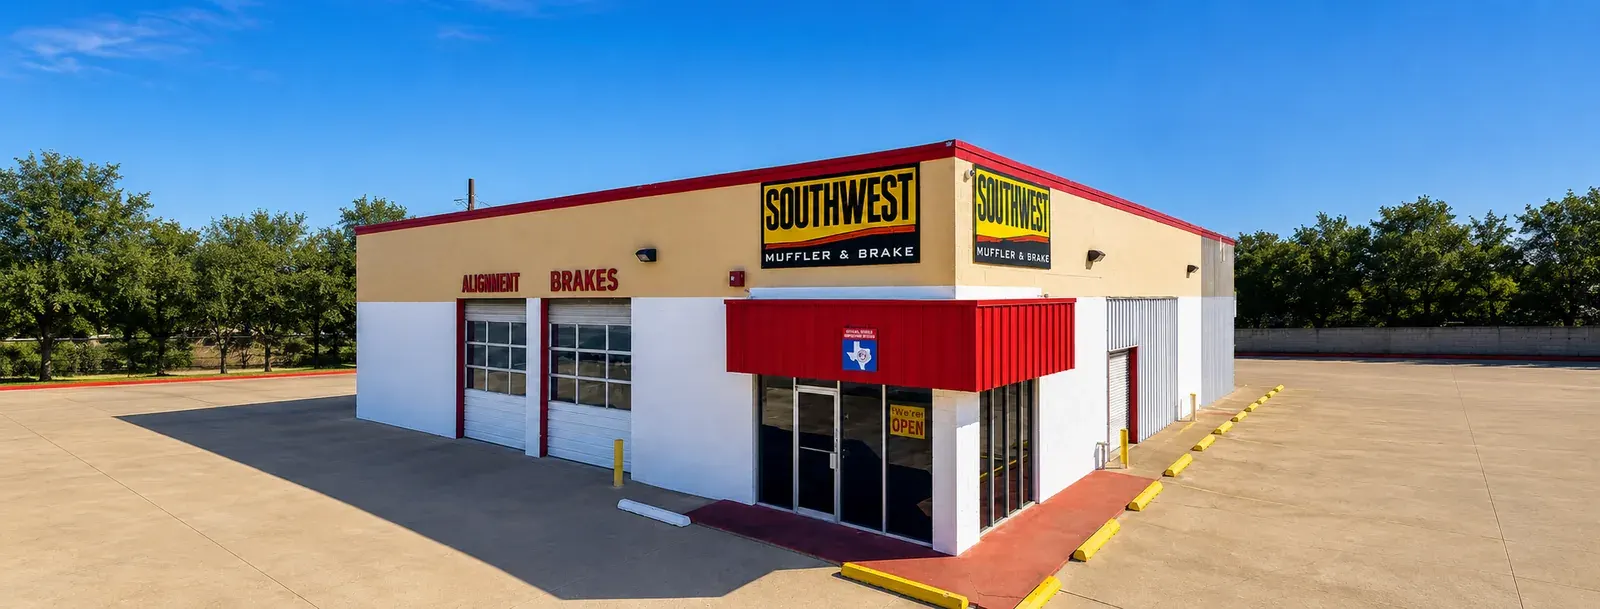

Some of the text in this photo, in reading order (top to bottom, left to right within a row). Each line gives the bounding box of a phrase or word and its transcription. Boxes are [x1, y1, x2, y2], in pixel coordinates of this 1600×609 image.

[766, 172, 914, 231] SOUTHWEST
[977, 174, 1049, 233] SOUTHWEST
[765, 246, 914, 262] MUFFLER & BRAKE
[976, 246, 1050, 263] MUFFLER & BRAKE
[462, 272, 520, 293] ALIGNMENT
[550, 268, 619, 292] BRAKES
[892, 418, 923, 436] OPEN
